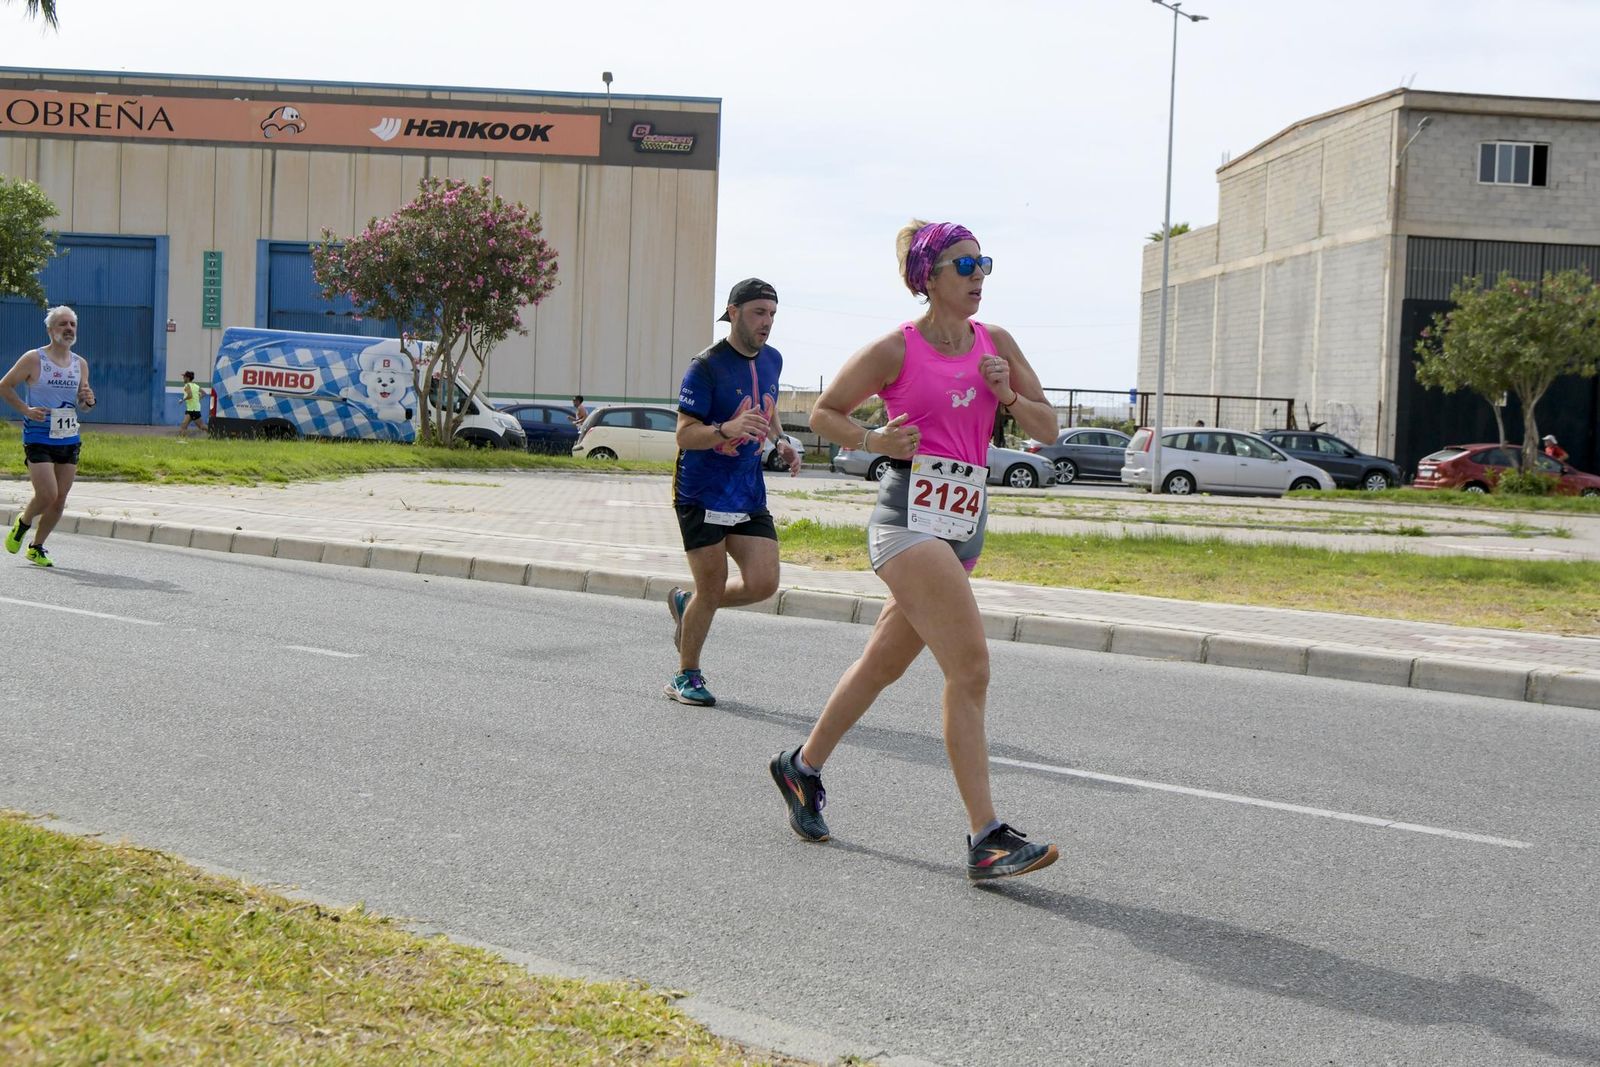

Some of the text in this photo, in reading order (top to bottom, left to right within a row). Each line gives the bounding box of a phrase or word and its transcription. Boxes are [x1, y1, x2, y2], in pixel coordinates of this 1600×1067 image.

[0, 98, 175, 132] OBREÑA
[383, 359, 390, 367] B
[242, 369, 315, 390] BIMBO
[913, 479, 980, 517] 2124
